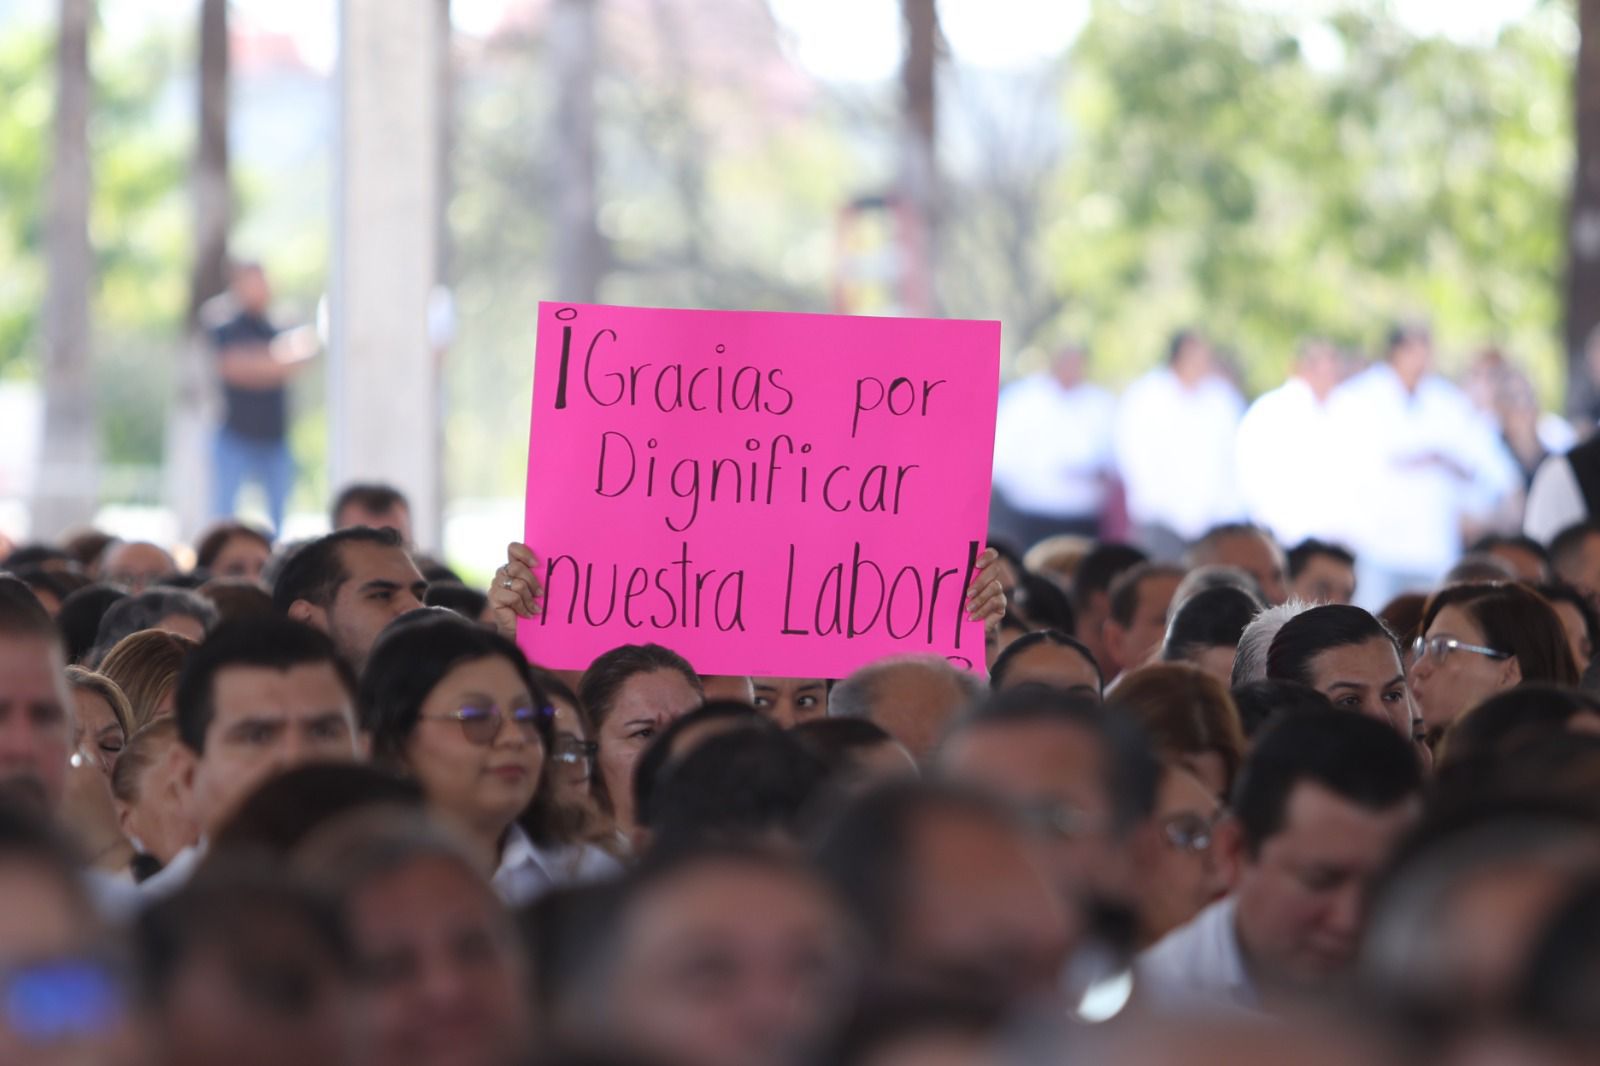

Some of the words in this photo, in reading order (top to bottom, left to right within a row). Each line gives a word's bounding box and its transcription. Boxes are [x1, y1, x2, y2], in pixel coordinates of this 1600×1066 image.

[554, 308, 793, 416] ¡Gracias
[851, 376, 947, 438] por
[594, 431, 920, 532] Dignificar
[540, 541, 746, 632] nuestra
[780, 541, 980, 671] Labor!
